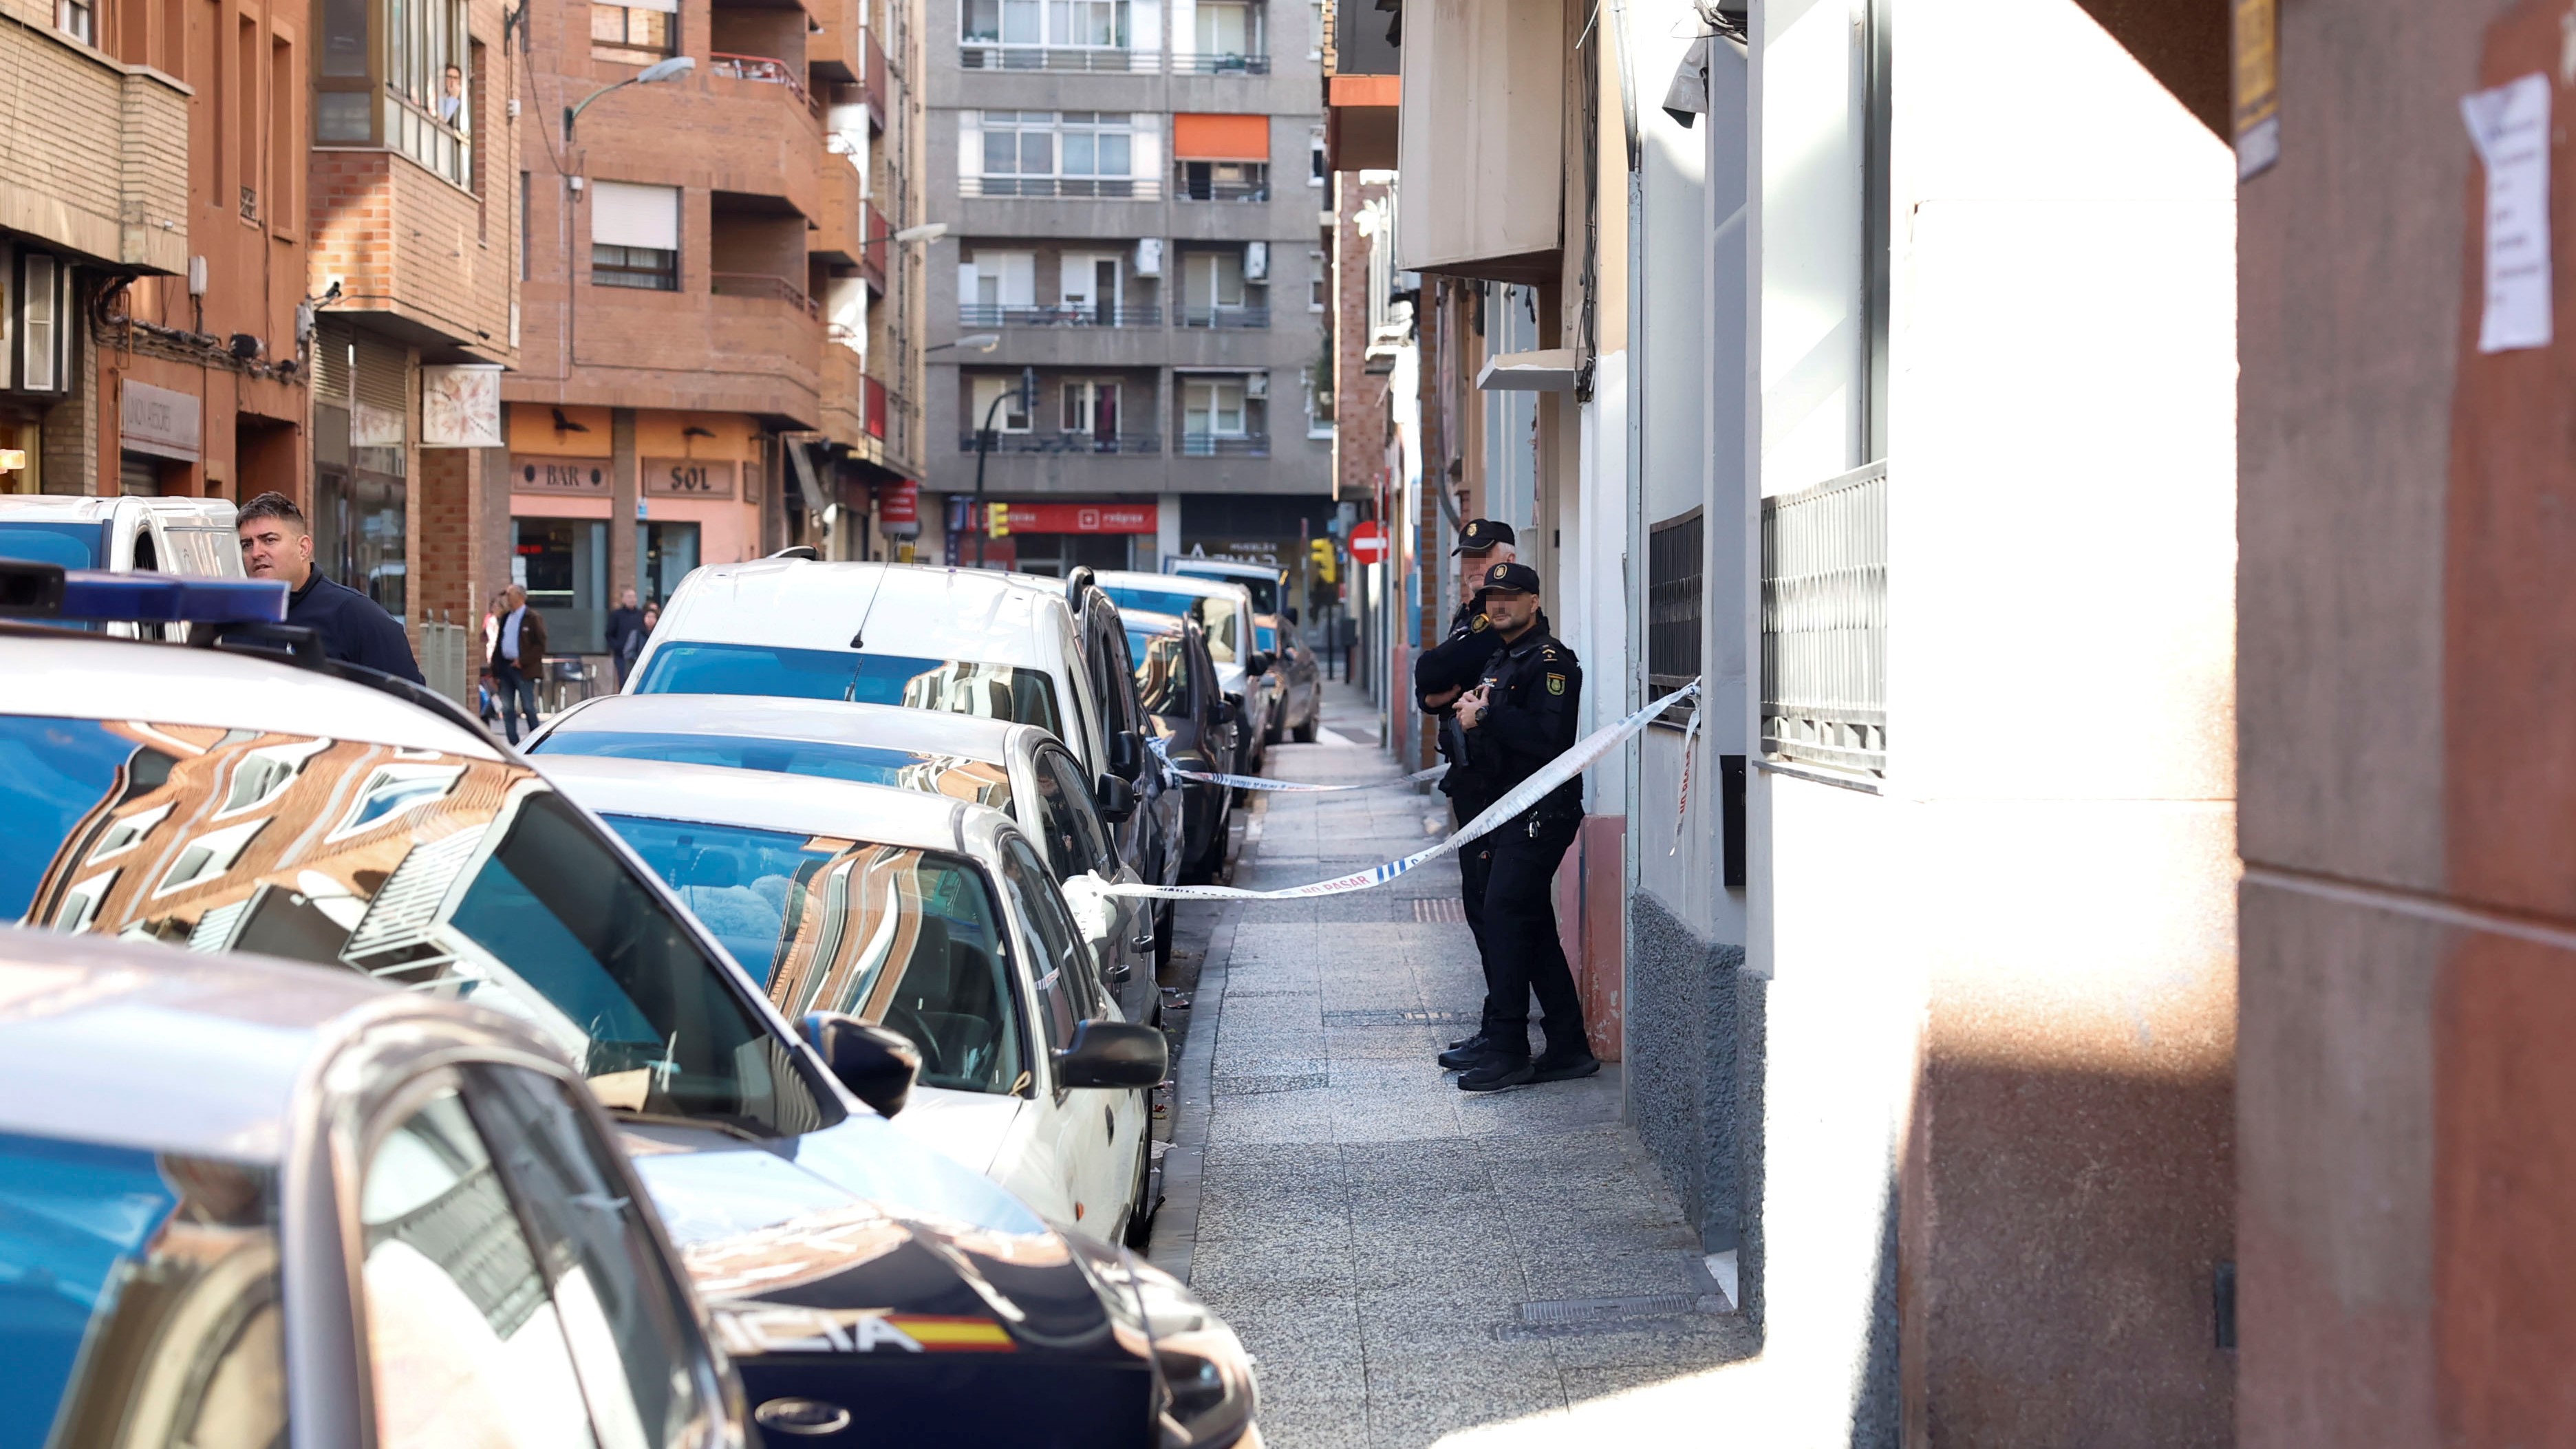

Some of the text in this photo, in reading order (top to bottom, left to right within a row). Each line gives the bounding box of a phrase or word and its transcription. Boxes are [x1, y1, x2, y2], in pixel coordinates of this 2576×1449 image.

[546, 464, 579, 487] BAR
[671, 466, 711, 491] SOL
[1322, 875, 1371, 890] PASAR
[713, 1309, 926, 1353] ICIA
